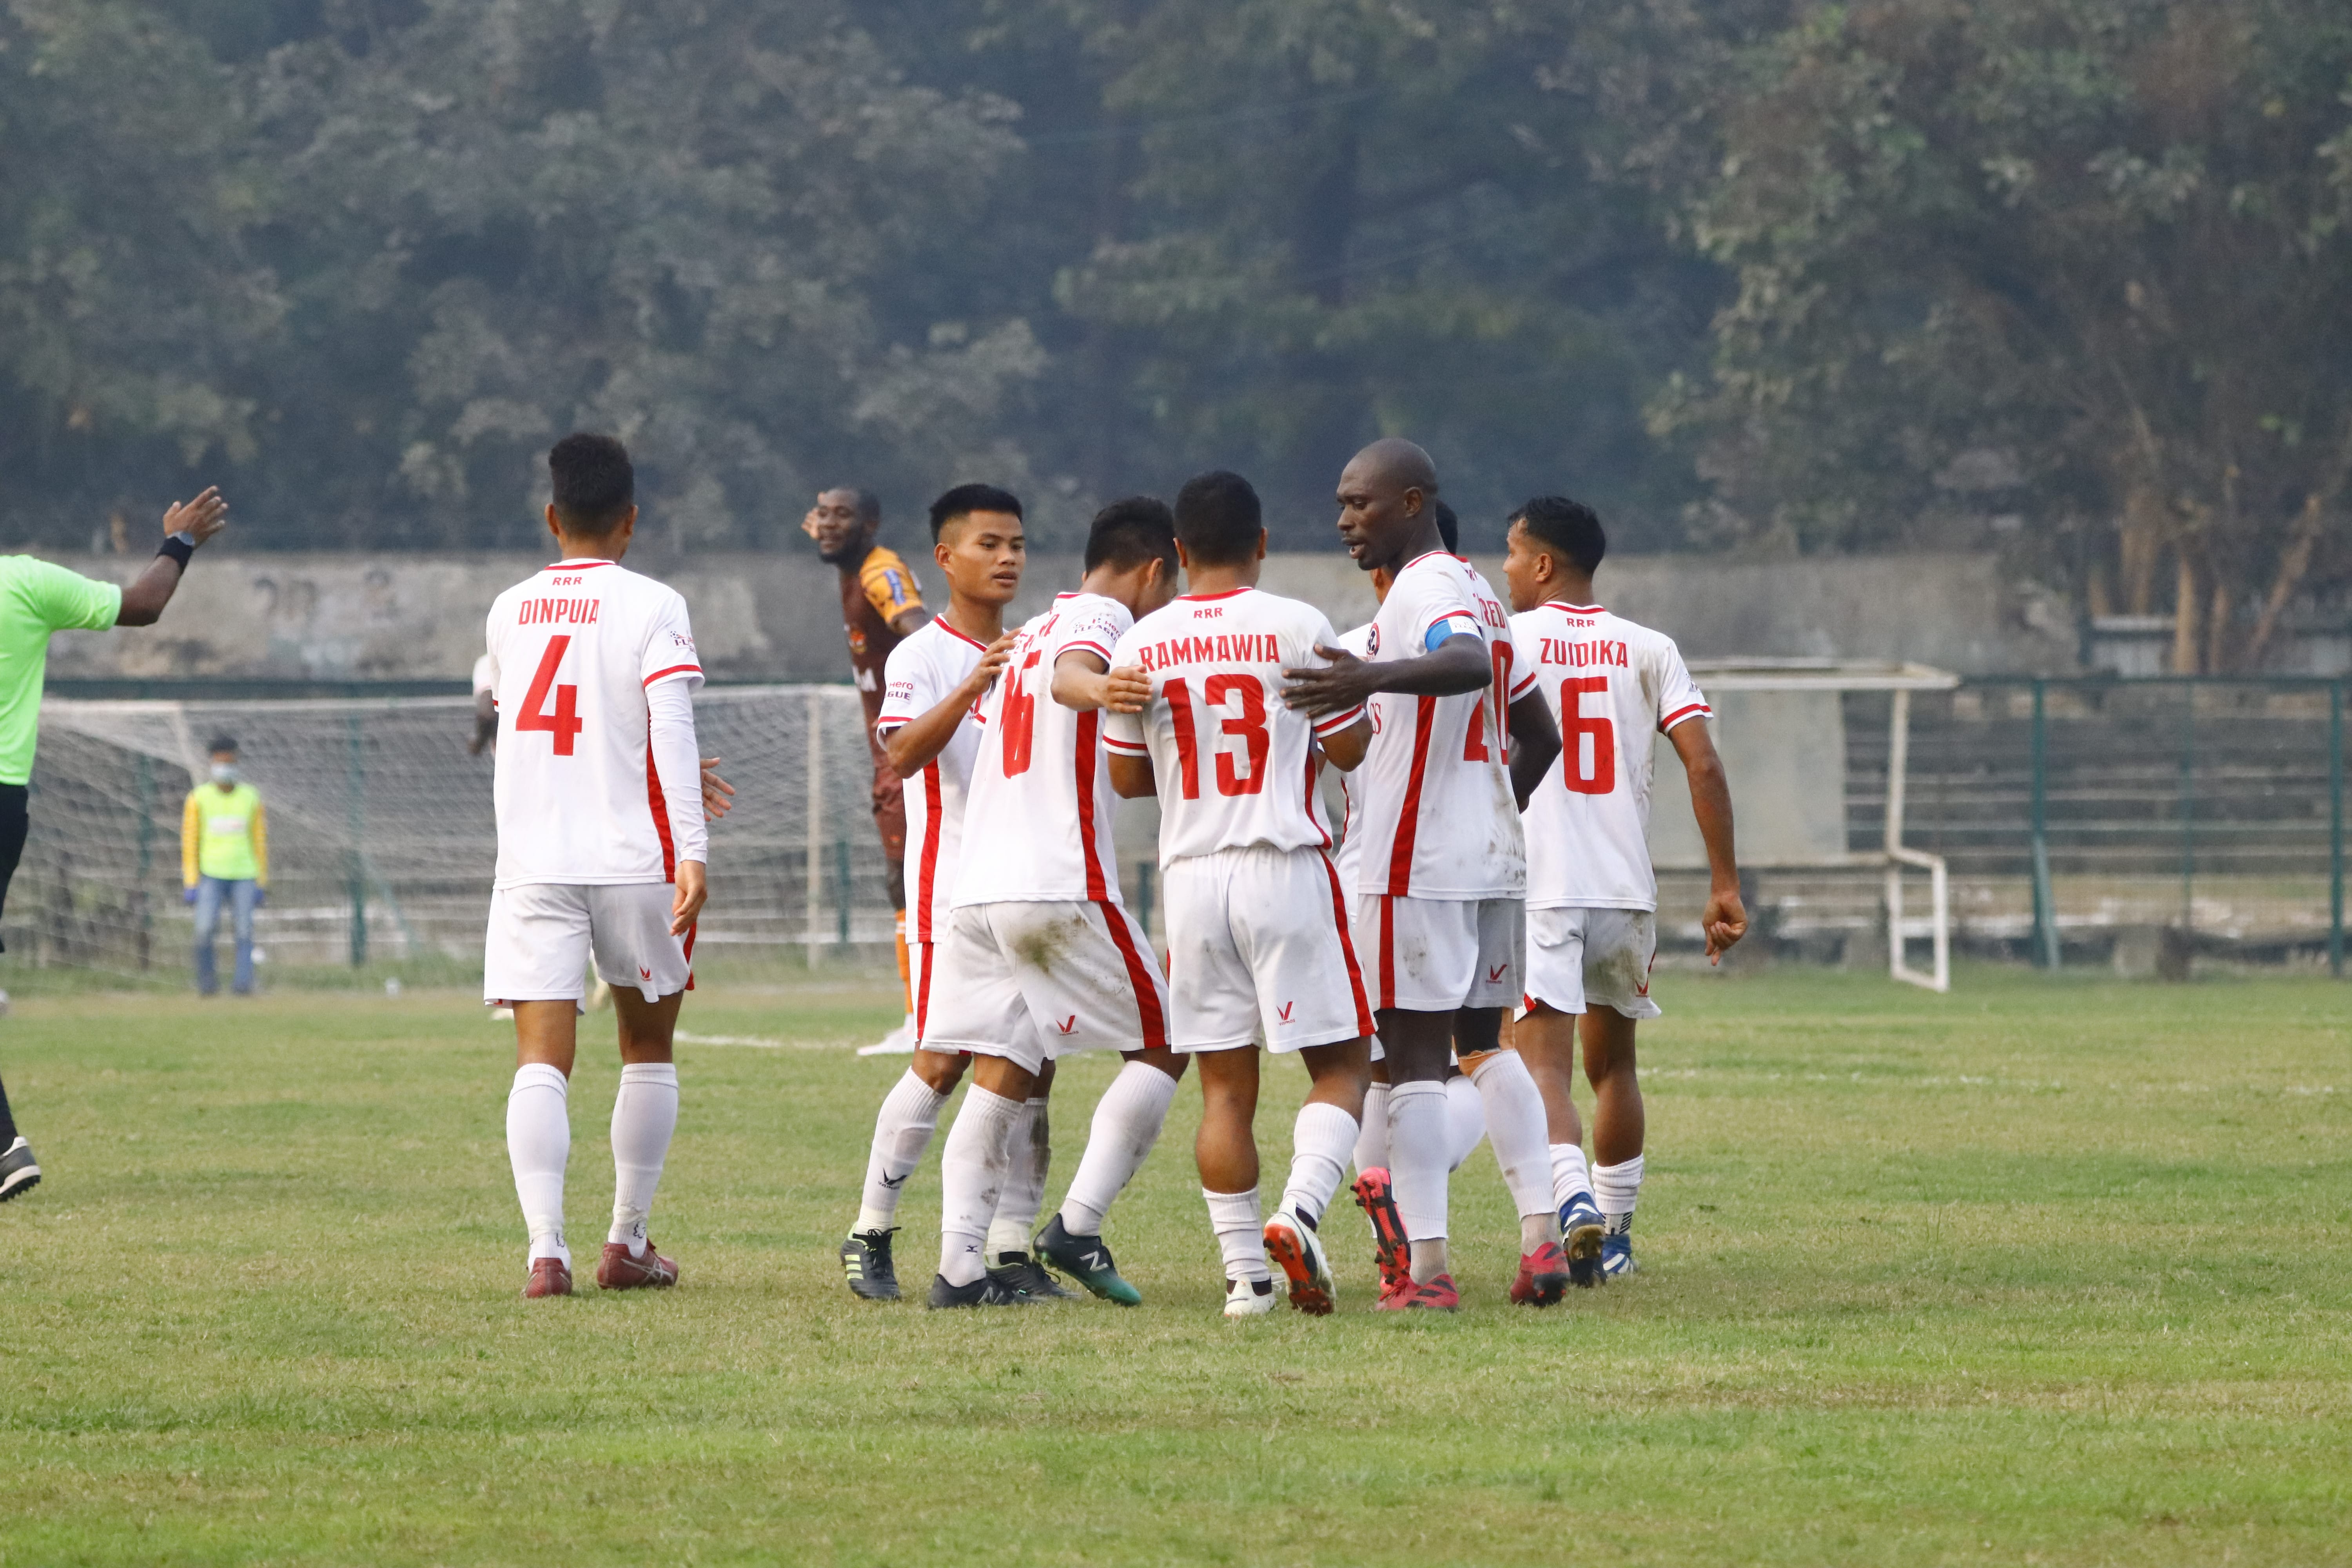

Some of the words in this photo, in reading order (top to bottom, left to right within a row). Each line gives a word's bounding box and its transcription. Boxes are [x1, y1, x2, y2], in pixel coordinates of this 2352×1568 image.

[553, 577, 583, 586] RRR
[519, 598, 600, 625] DINPUIA
[1194, 607, 1223, 619] RRR
[1567, 618, 1596, 628] RRR
[1138, 634, 1280, 674] RAMMAWIA
[1540, 638, 1628, 668] ZUIDIKA
[515, 635, 583, 757] 4
[886, 691, 911, 701] GUE
[889, 681, 913, 690] Hero
[1161, 673, 1270, 800] 13
[1561, 676, 1615, 795] 6
